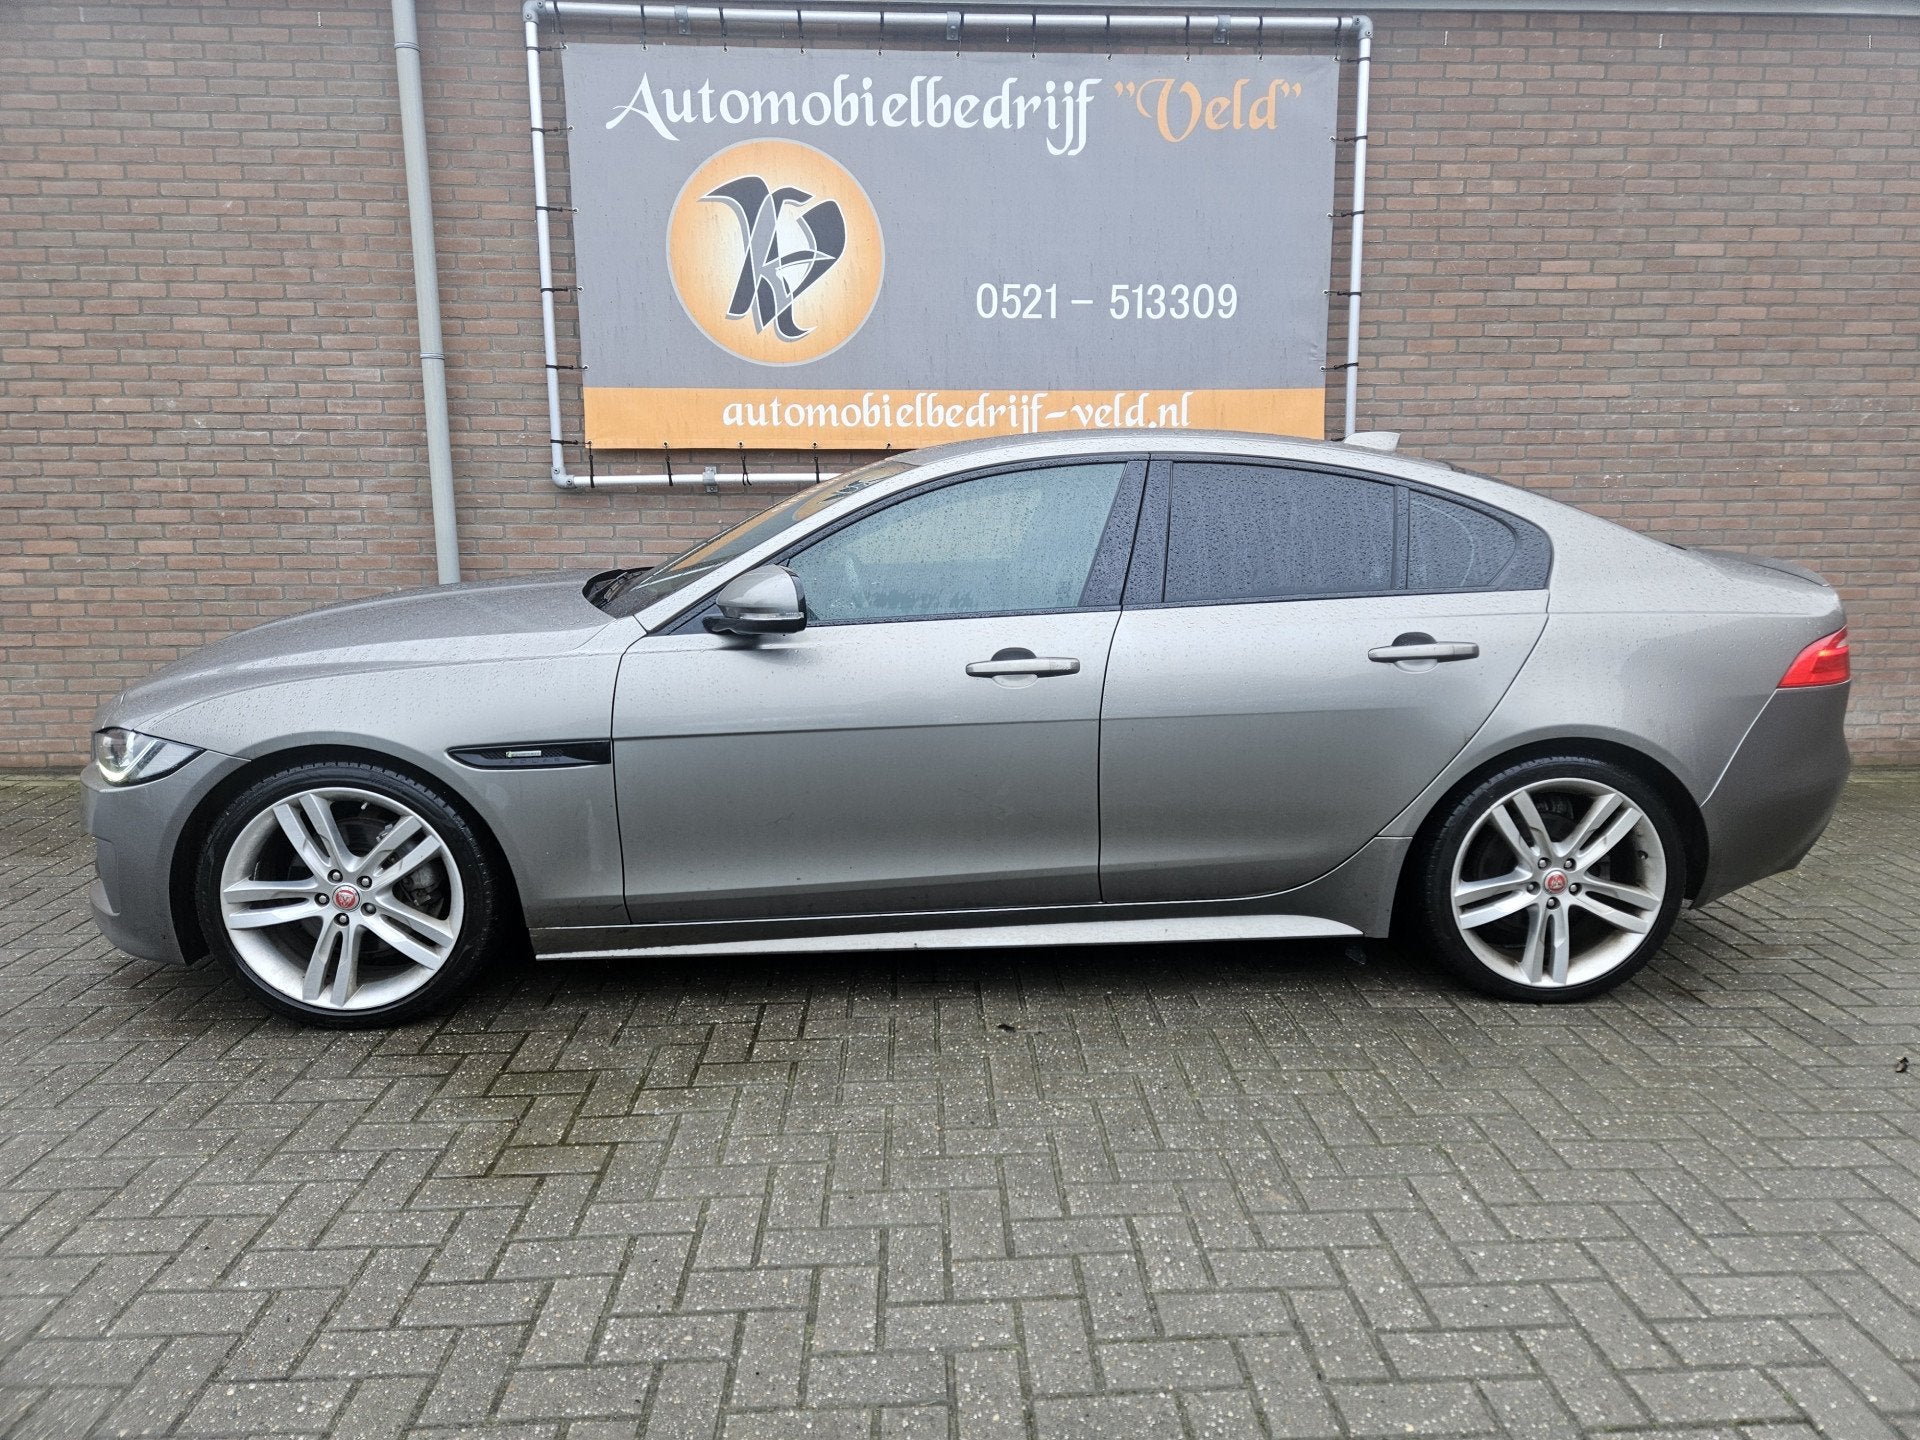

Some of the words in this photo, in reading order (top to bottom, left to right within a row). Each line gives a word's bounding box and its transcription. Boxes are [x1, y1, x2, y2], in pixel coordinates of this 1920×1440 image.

[605, 72, 1103, 156] Automobielbedrijf
[975, 282, 1058, 320] 0521
[1108, 283, 1239, 320] 513309
[722, 391, 1194, 434] automobielbedrijf-veld.nl
